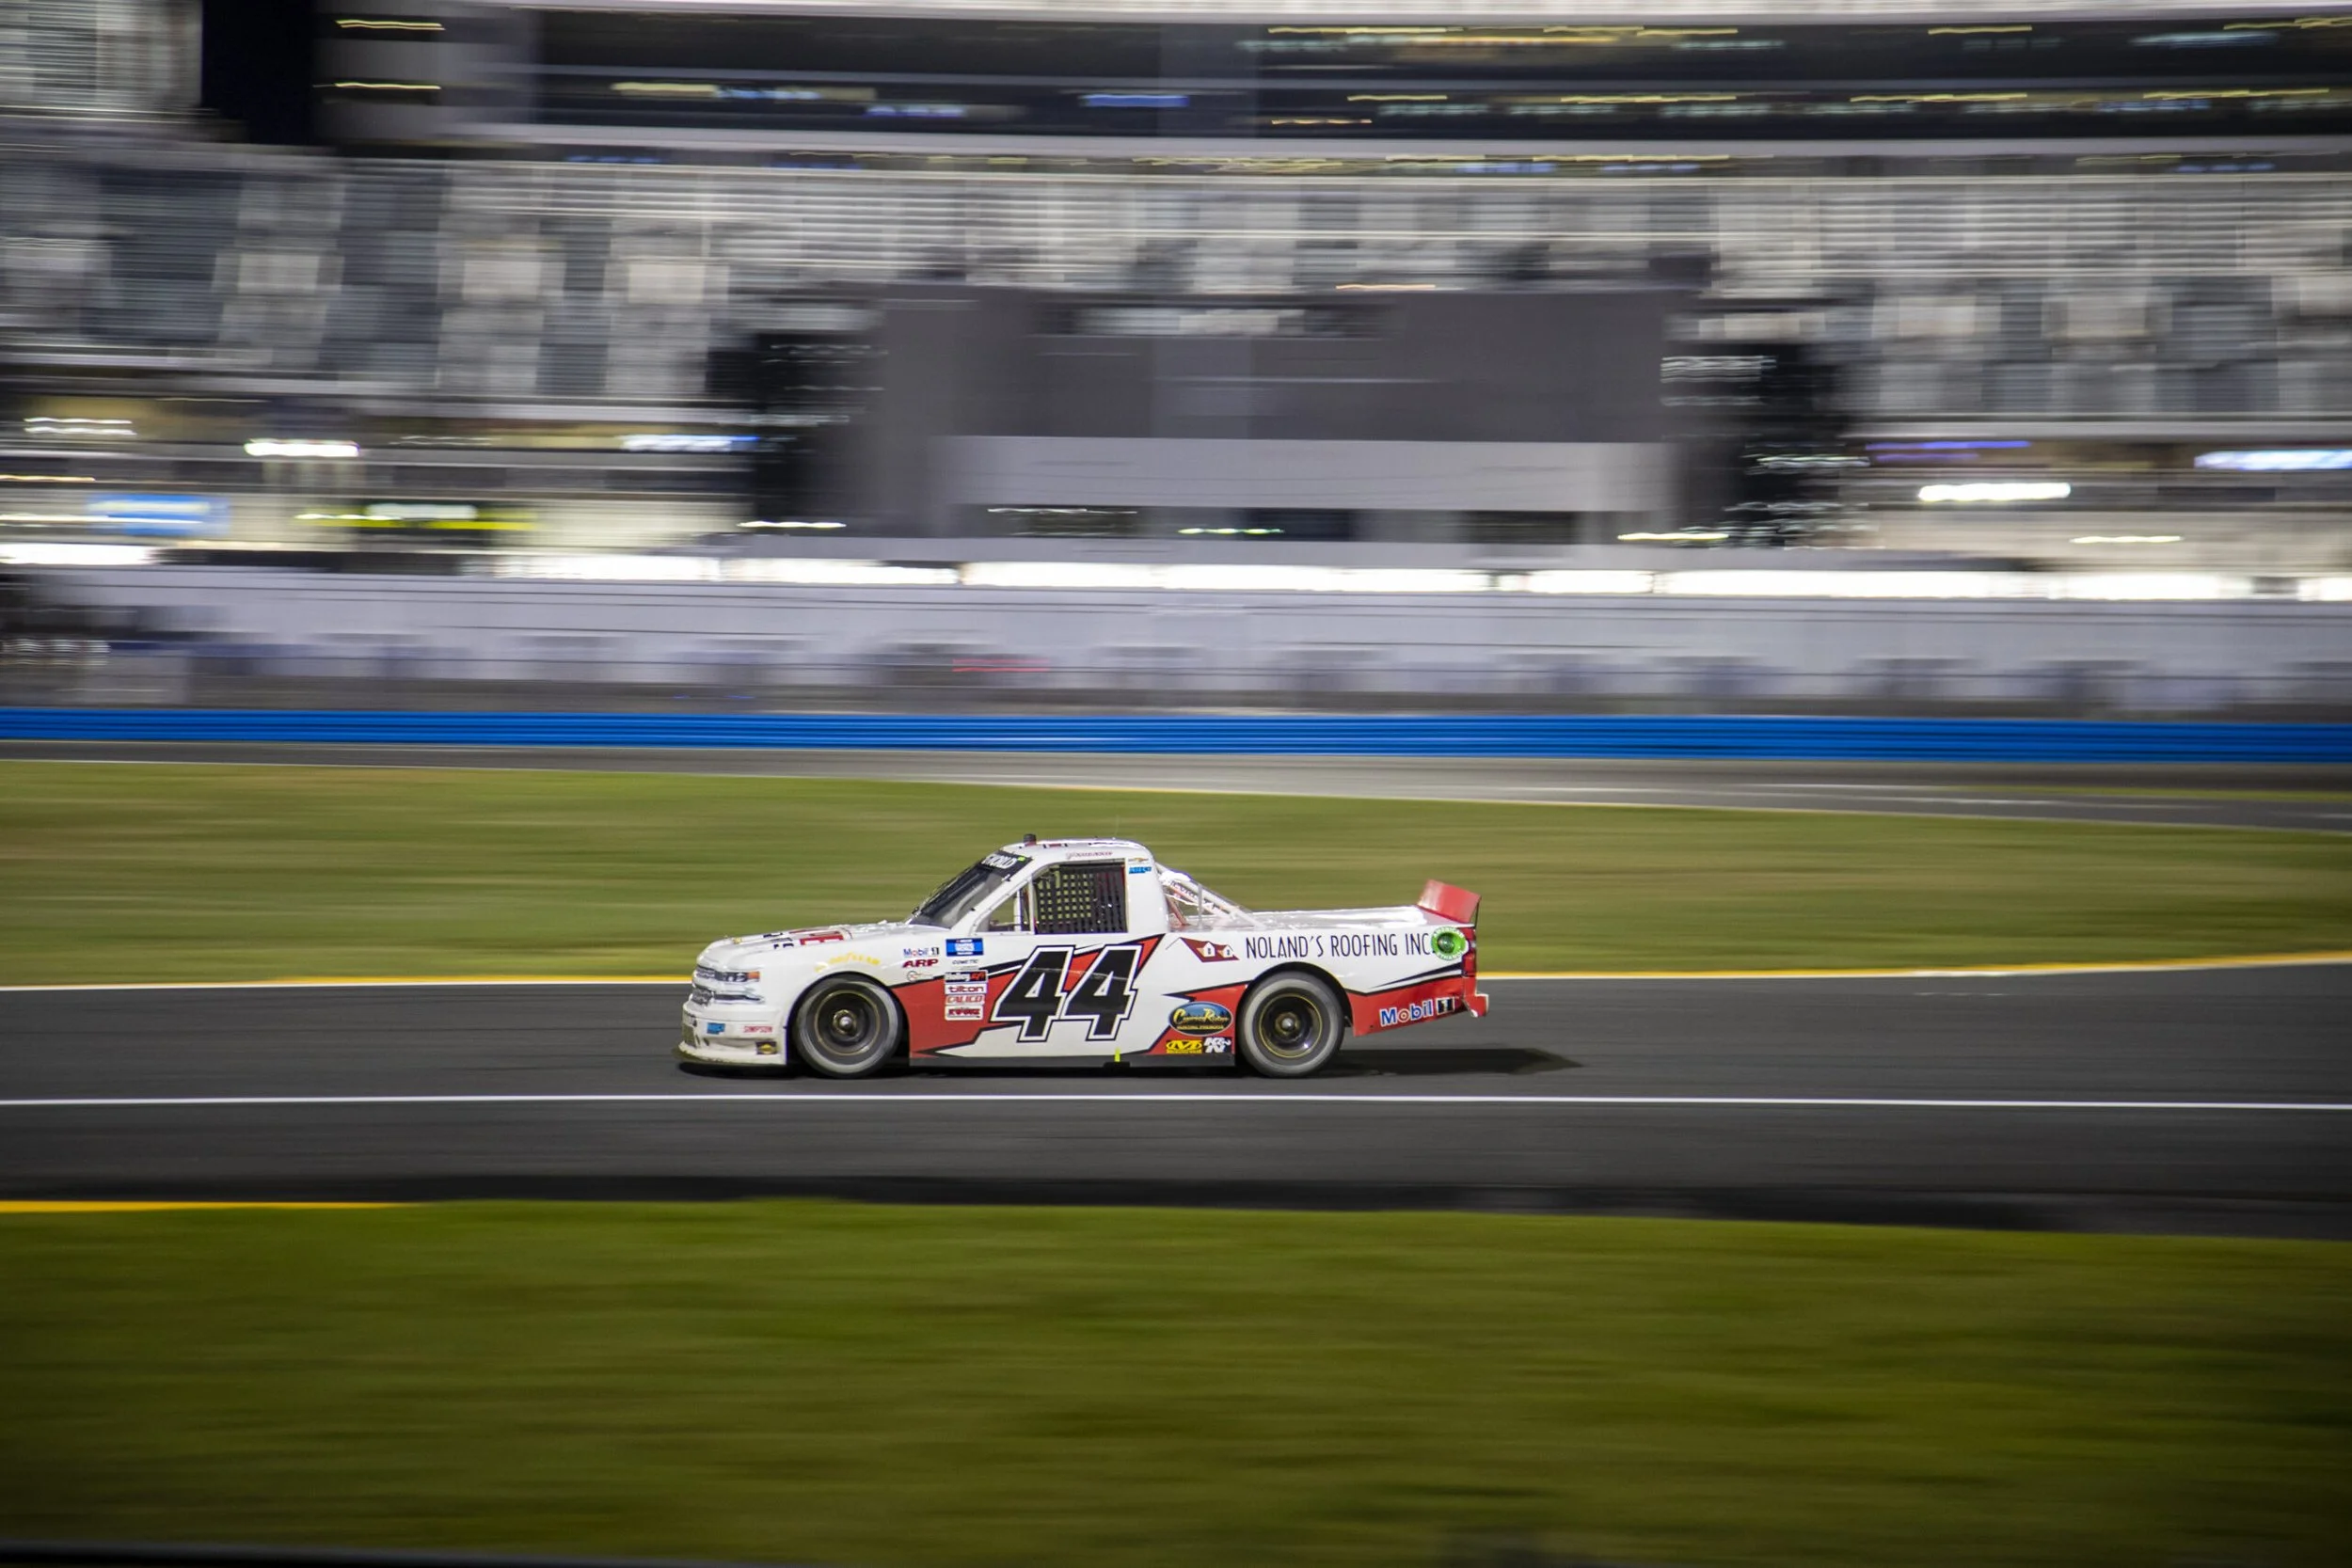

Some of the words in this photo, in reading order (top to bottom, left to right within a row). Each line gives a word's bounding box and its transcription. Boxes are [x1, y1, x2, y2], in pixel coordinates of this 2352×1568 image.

[903, 947, 929, 957] Mobil
[1245, 935, 1324, 958] NOLAND'S
[1331, 933, 1398, 958] ROOFING
[902, 958, 939, 968] ARP
[947, 985, 984, 993] tilton
[990, 944, 1144, 1043] 44
[1378, 999, 1434, 1028] Mobil
